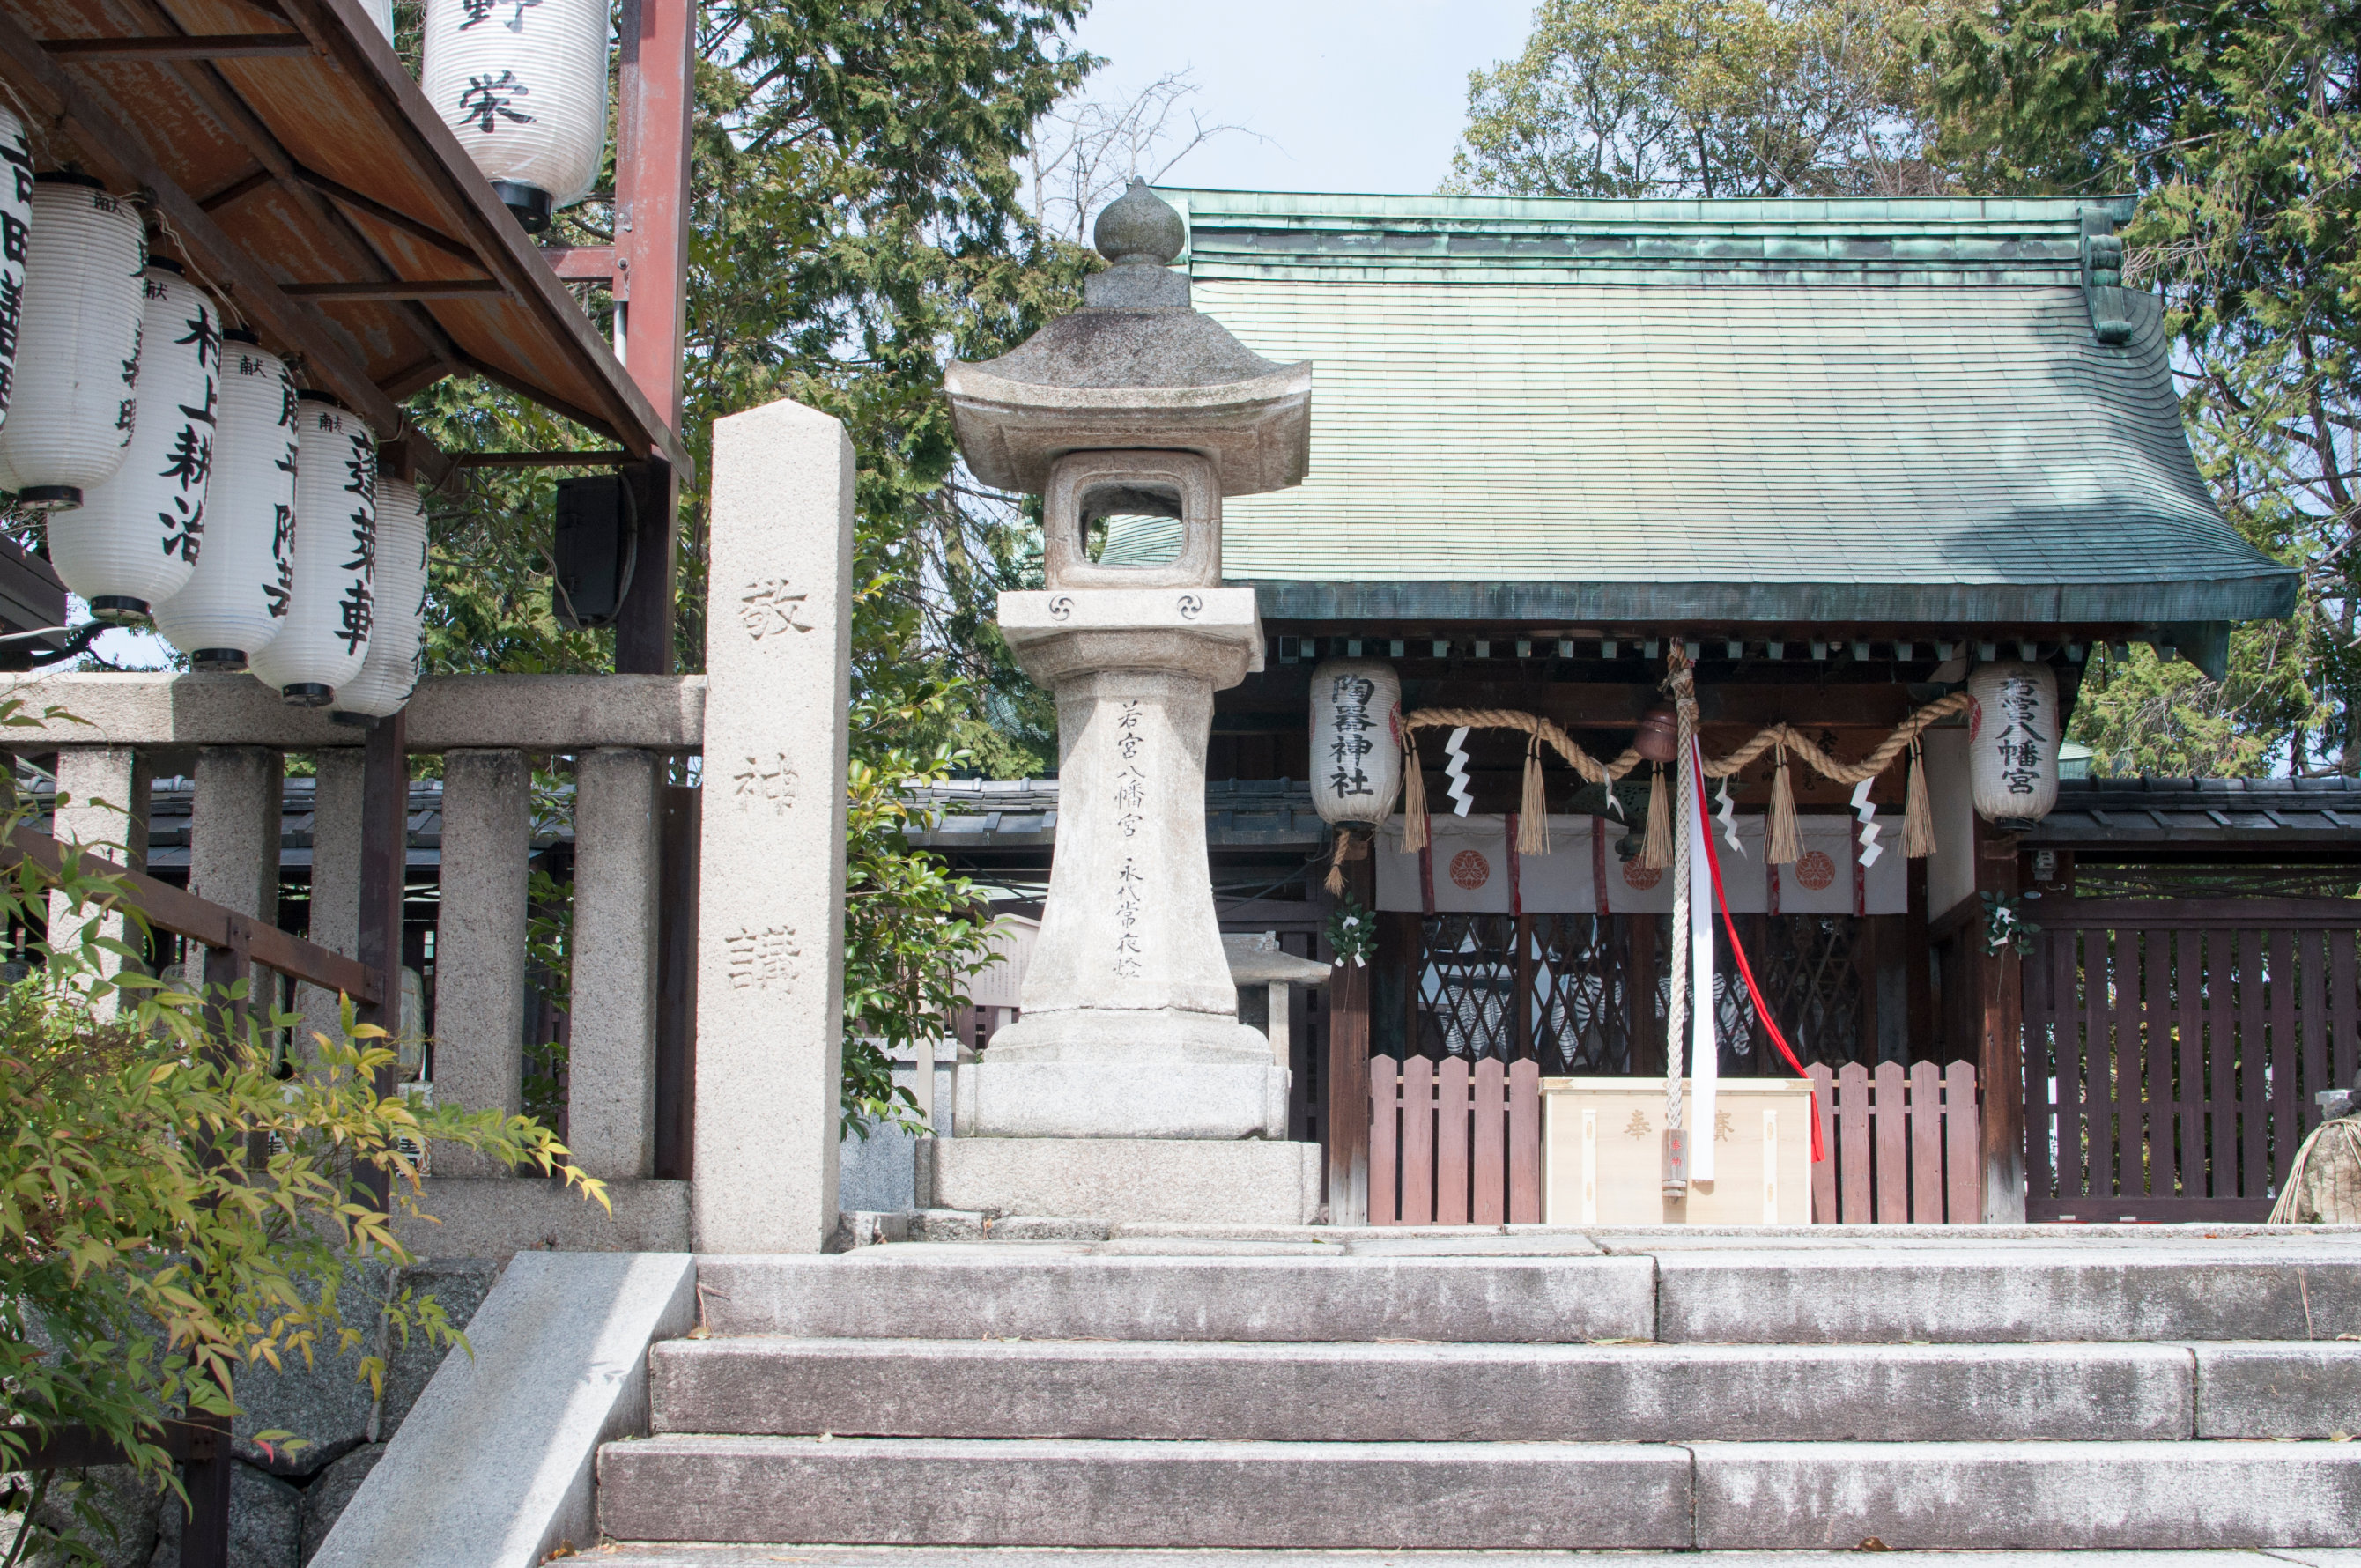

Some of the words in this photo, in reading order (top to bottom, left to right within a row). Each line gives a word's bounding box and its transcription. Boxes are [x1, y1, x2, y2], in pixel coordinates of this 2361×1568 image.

[240, 354, 267, 379] 献
[318, 411, 344, 435] 献
[158, 303, 222, 567] 村上耕治
[721, 578, 815, 995] 敬神講
[1114, 700, 1145, 838] 若宮八幡宮
[1329, 673, 1378, 799] 陶器神社
[1995, 670, 2046, 795] 若宮八幡宮
